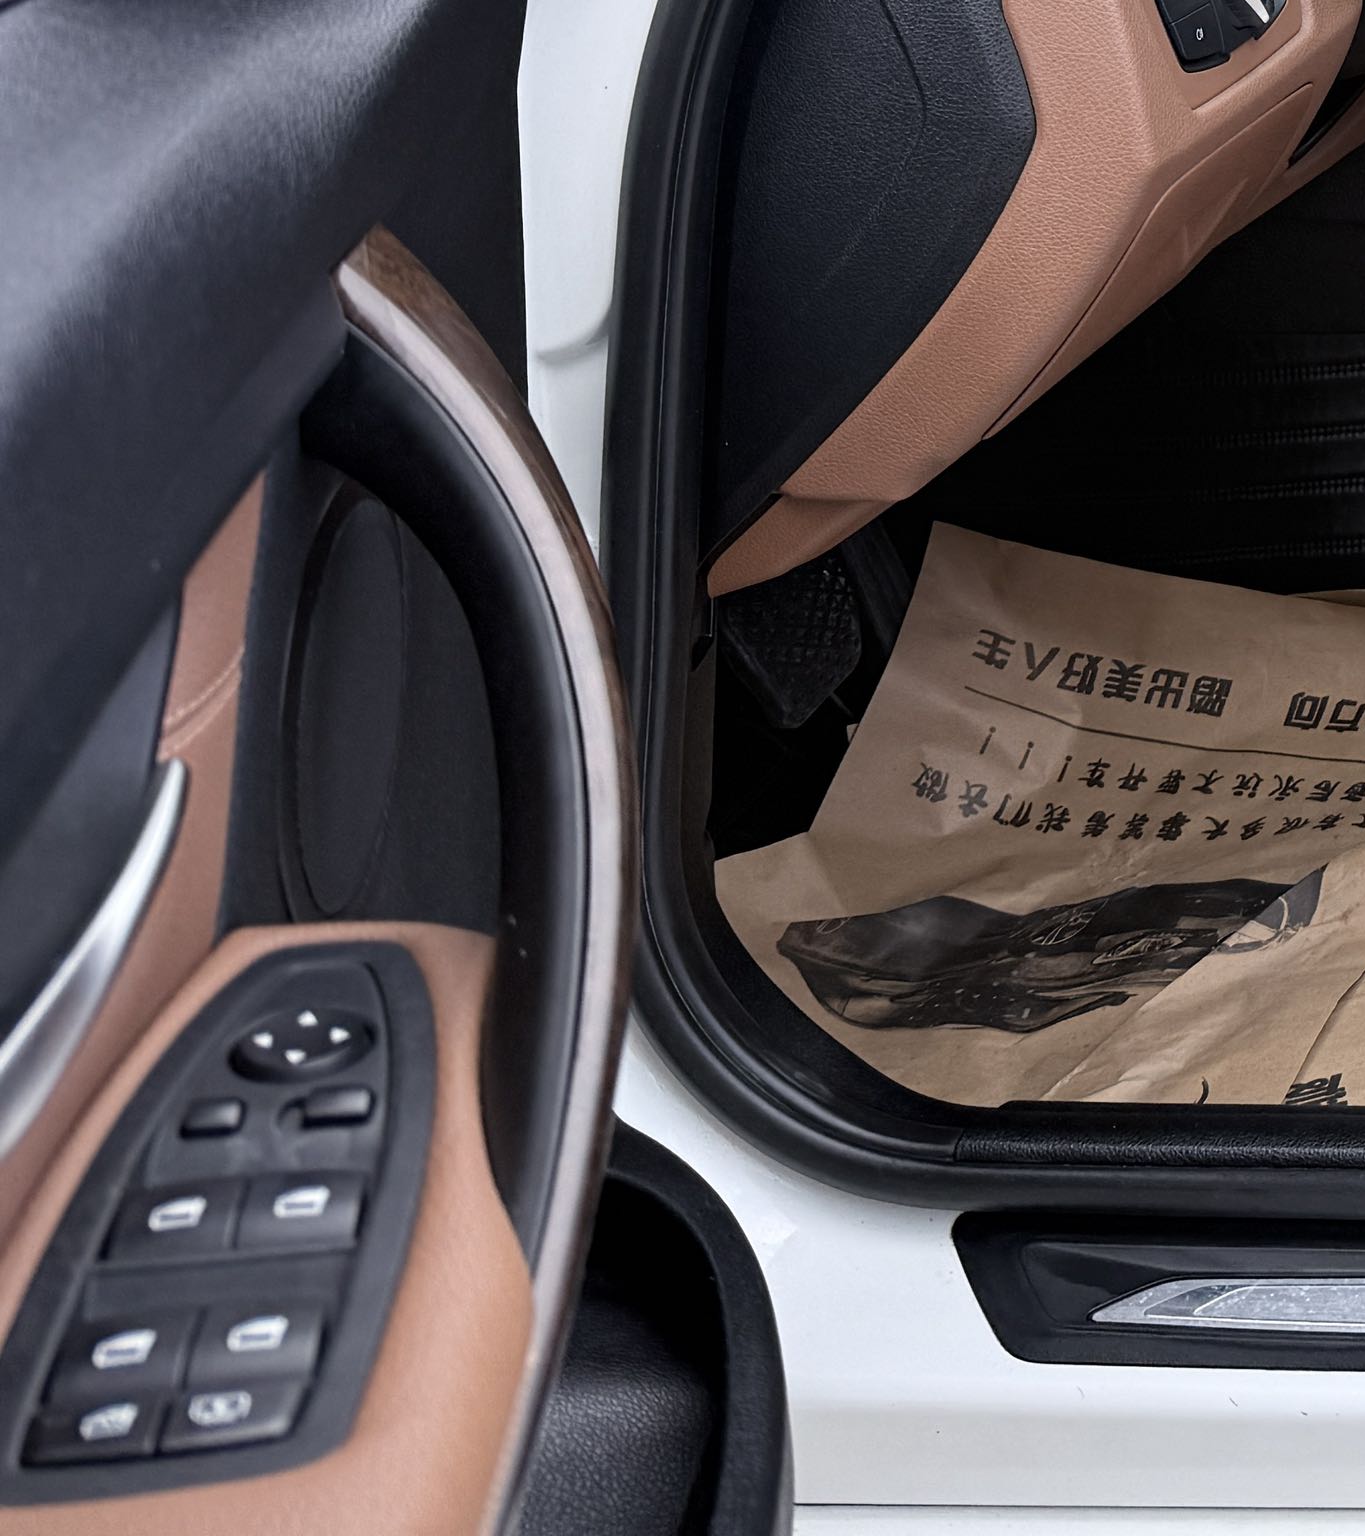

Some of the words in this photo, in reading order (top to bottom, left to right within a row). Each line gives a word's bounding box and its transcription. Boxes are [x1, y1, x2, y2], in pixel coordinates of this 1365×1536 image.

[973, 628, 1234, 718] 踏出美好人生
